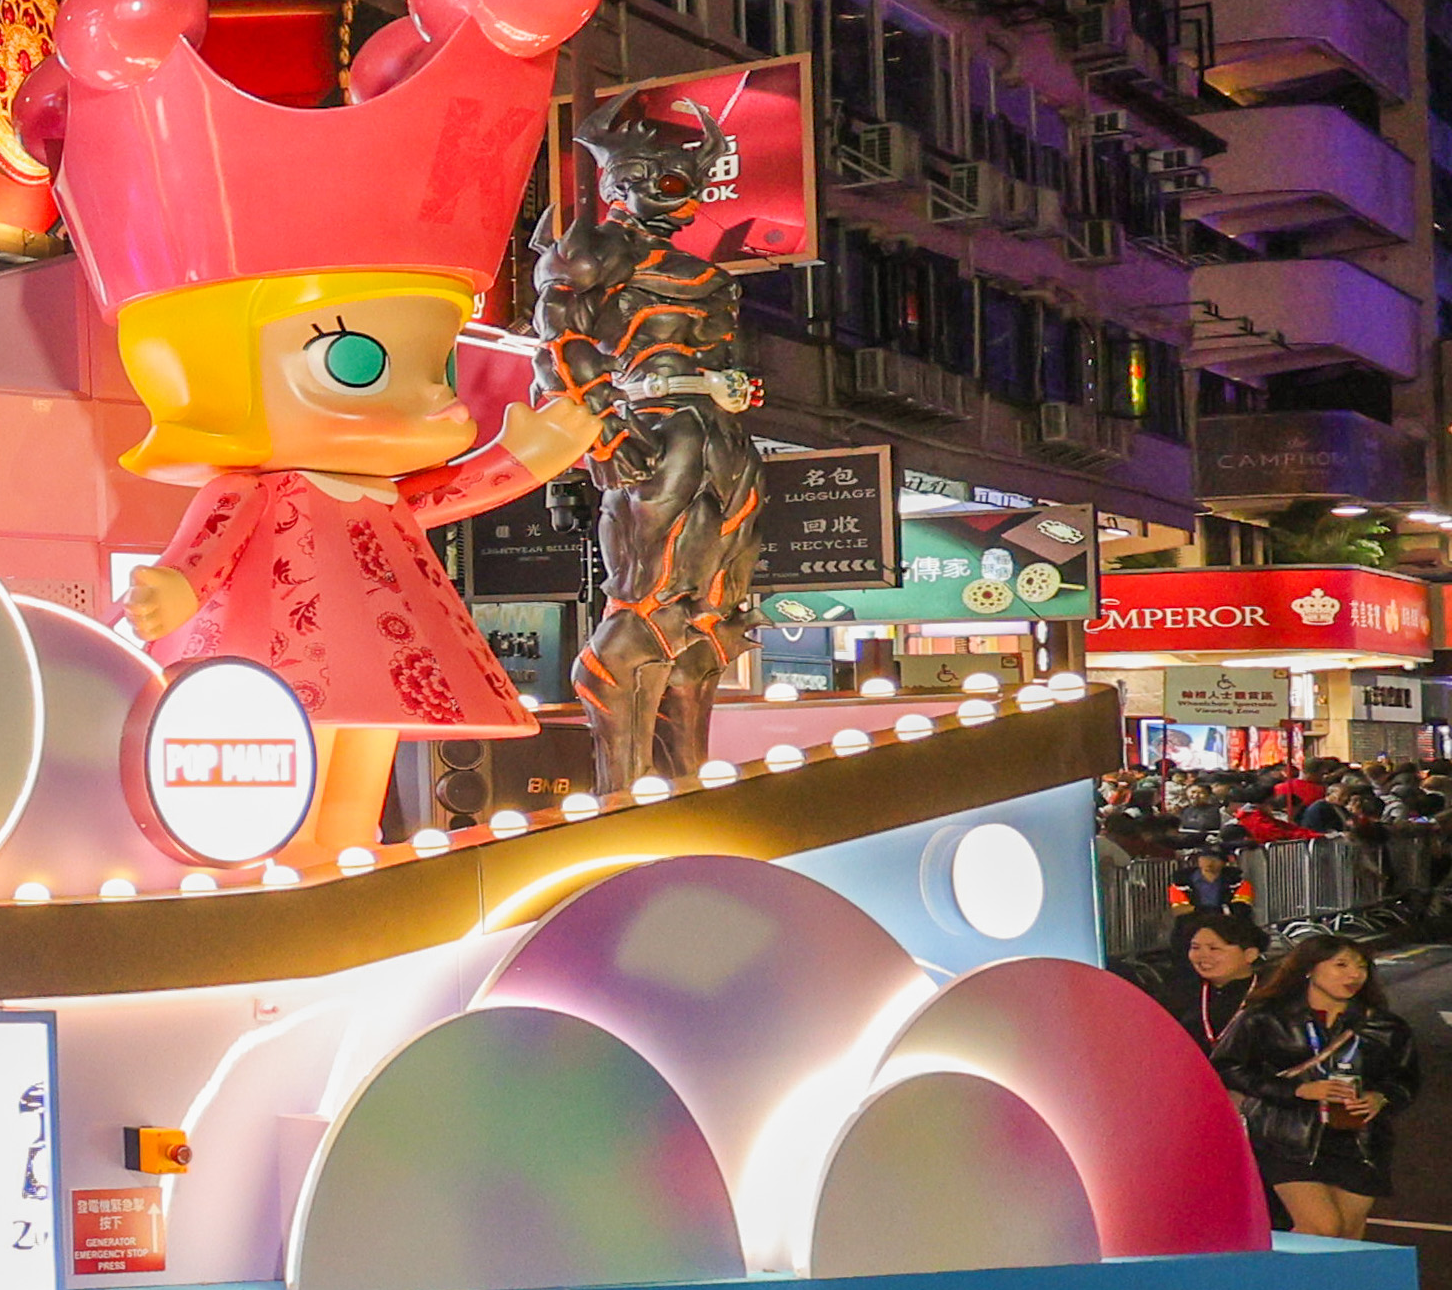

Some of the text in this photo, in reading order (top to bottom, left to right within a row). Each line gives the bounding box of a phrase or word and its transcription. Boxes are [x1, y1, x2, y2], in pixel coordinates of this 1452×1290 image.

[802, 466, 859, 488] 名包
[802, 515, 862, 535] 回收
[790, 538, 870, 552] RECYCLE
[165, 743, 294, 782] POP MART
[99, 1215, 124, 1231] 按下
[85, 1236, 137, 1248] GENERATOR
[74, 1248, 150, 1260] EMERGENCY STOP
[97, 1260, 127, 1271] PRESS
